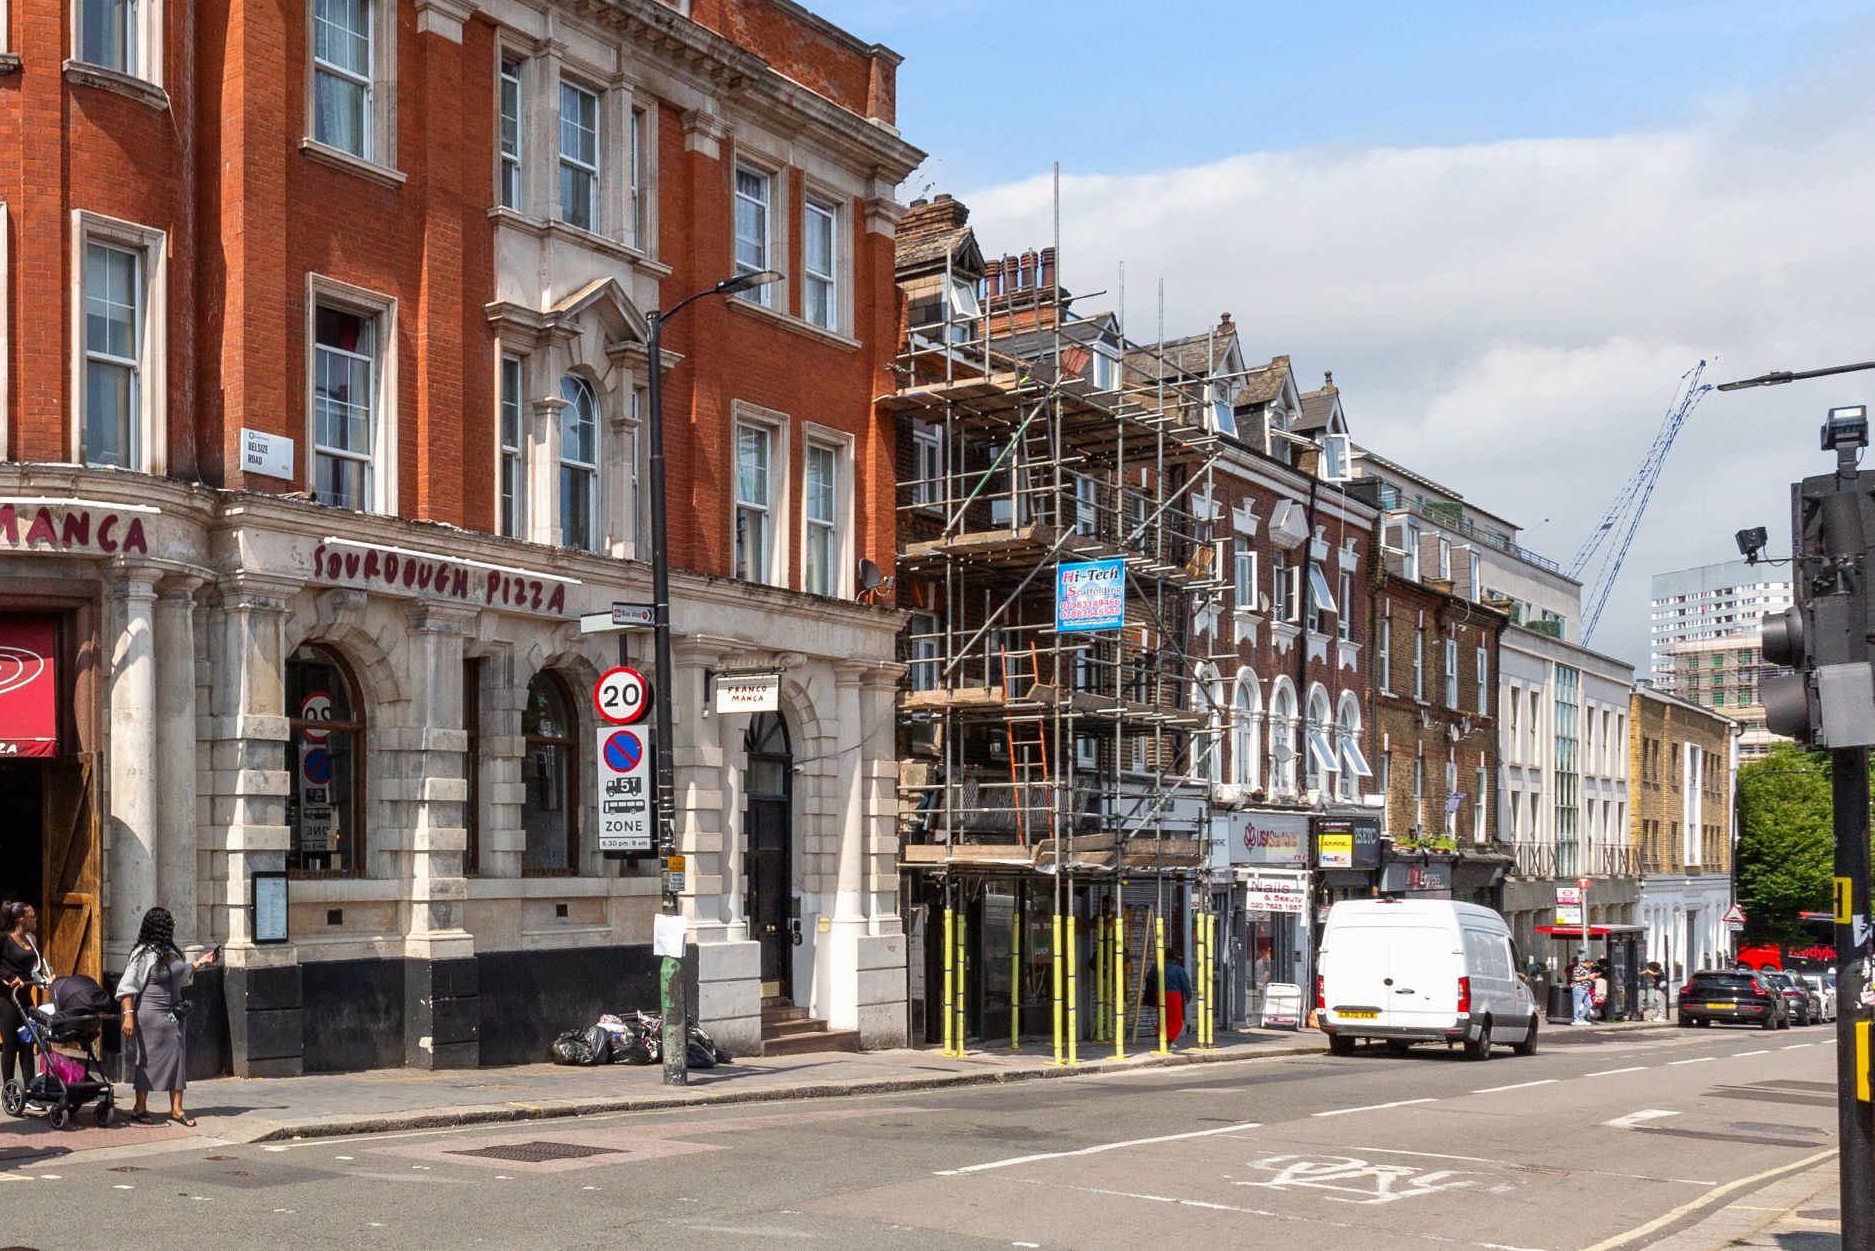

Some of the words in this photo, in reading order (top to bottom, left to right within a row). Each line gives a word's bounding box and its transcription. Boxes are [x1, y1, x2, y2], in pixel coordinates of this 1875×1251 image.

[248, 442, 268, 454] BELSIZE
[248, 454, 263, 466] ROAD
[314, 544, 468, 599] SOURDOUGH
[486, 570, 566, 614] PIZZA
[603, 683, 640, 707] 20
[727, 685, 767, 694] FRANCO
[620, 778, 637, 793] 5T
[605, 820, 643, 832] ZONE
[602, 840, 618, 848] 6.30
[618, 841, 628, 849] pm
[1251, 880, 1291, 894] Nails
[1274, 895, 1303, 903] Beauty
